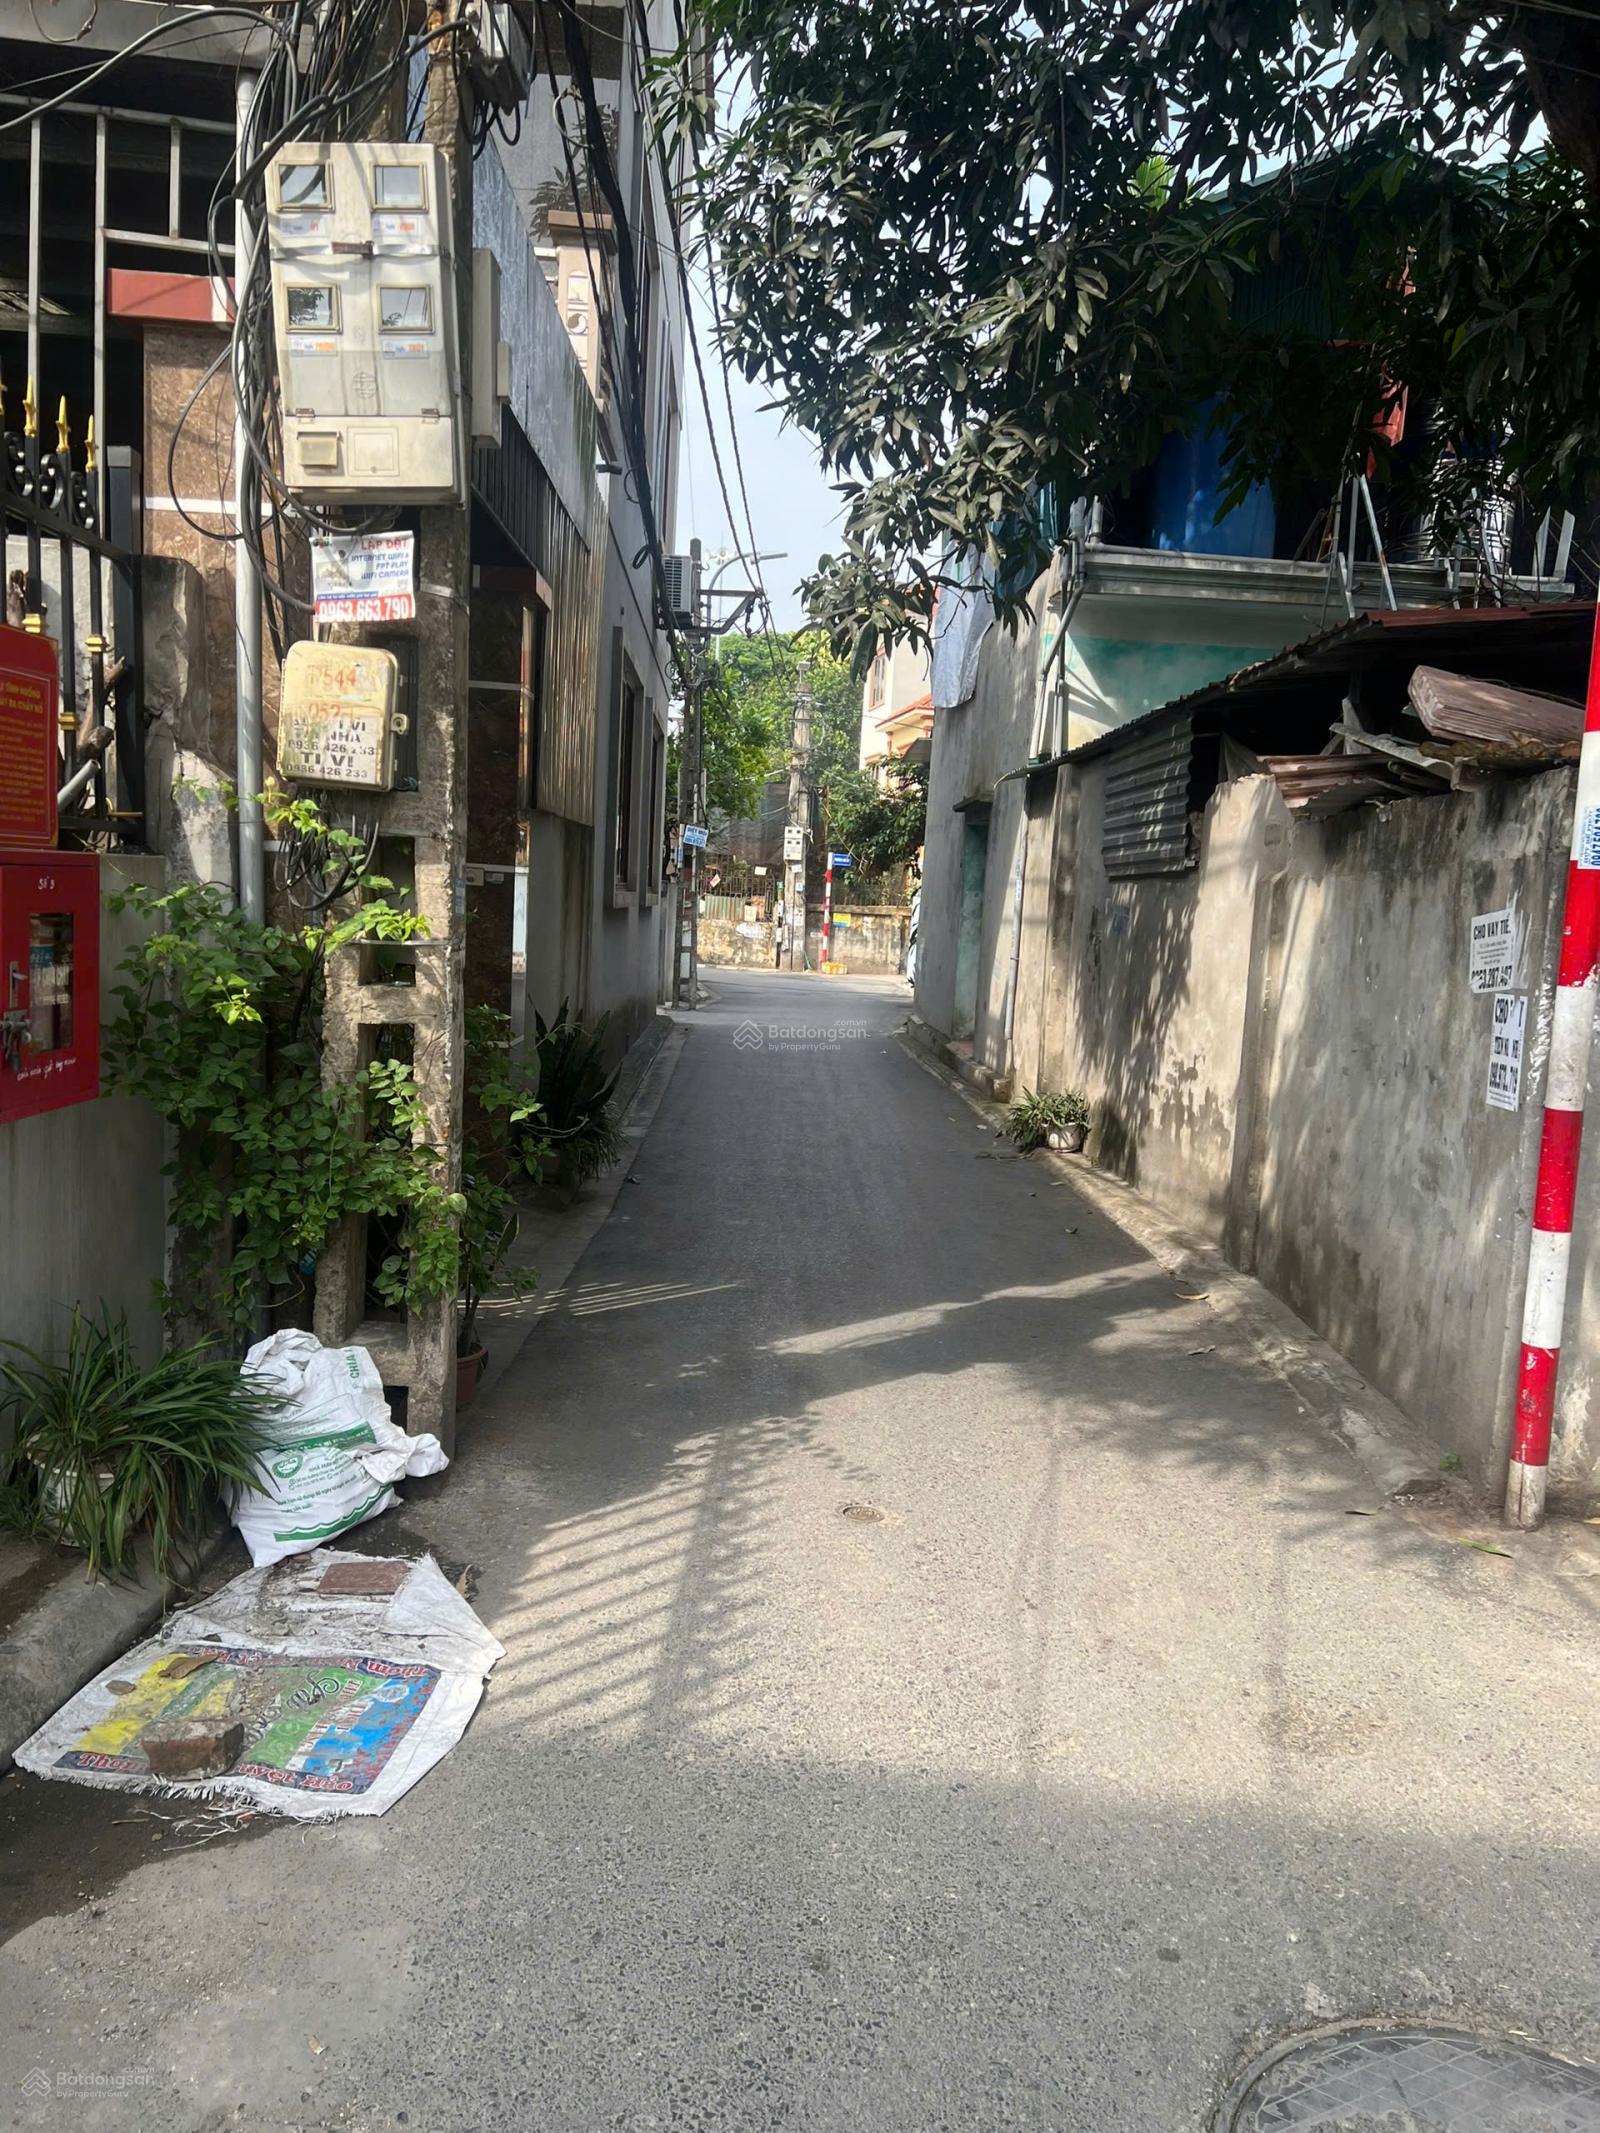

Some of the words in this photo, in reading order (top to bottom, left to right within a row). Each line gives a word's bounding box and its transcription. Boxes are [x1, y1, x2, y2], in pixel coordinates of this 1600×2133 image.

[352, 553, 386, 561] INTERNET
[388, 552, 404, 560] WIFI
[376, 562, 390, 570] FPT
[391, 561, 408, 569] PLAY
[361, 572, 377, 580] WIFI
[378, 570, 409, 578] CAMERA
[319, 597, 409, 622] 0963.663.790
[300, 751, 321, 765] TI
[319, 766, 341, 776] 426
[345, 768, 368, 778] 233
[1474, 924, 1486, 940] CHO
[1487, 920, 1499, 938] VAY
[1495, 998, 1509, 1024] CHO
[346, 1353, 359, 1379] CHIA
[238, 1763, 295, 1785] uyệt
[299, 1775, 354, 1793] Hảo
